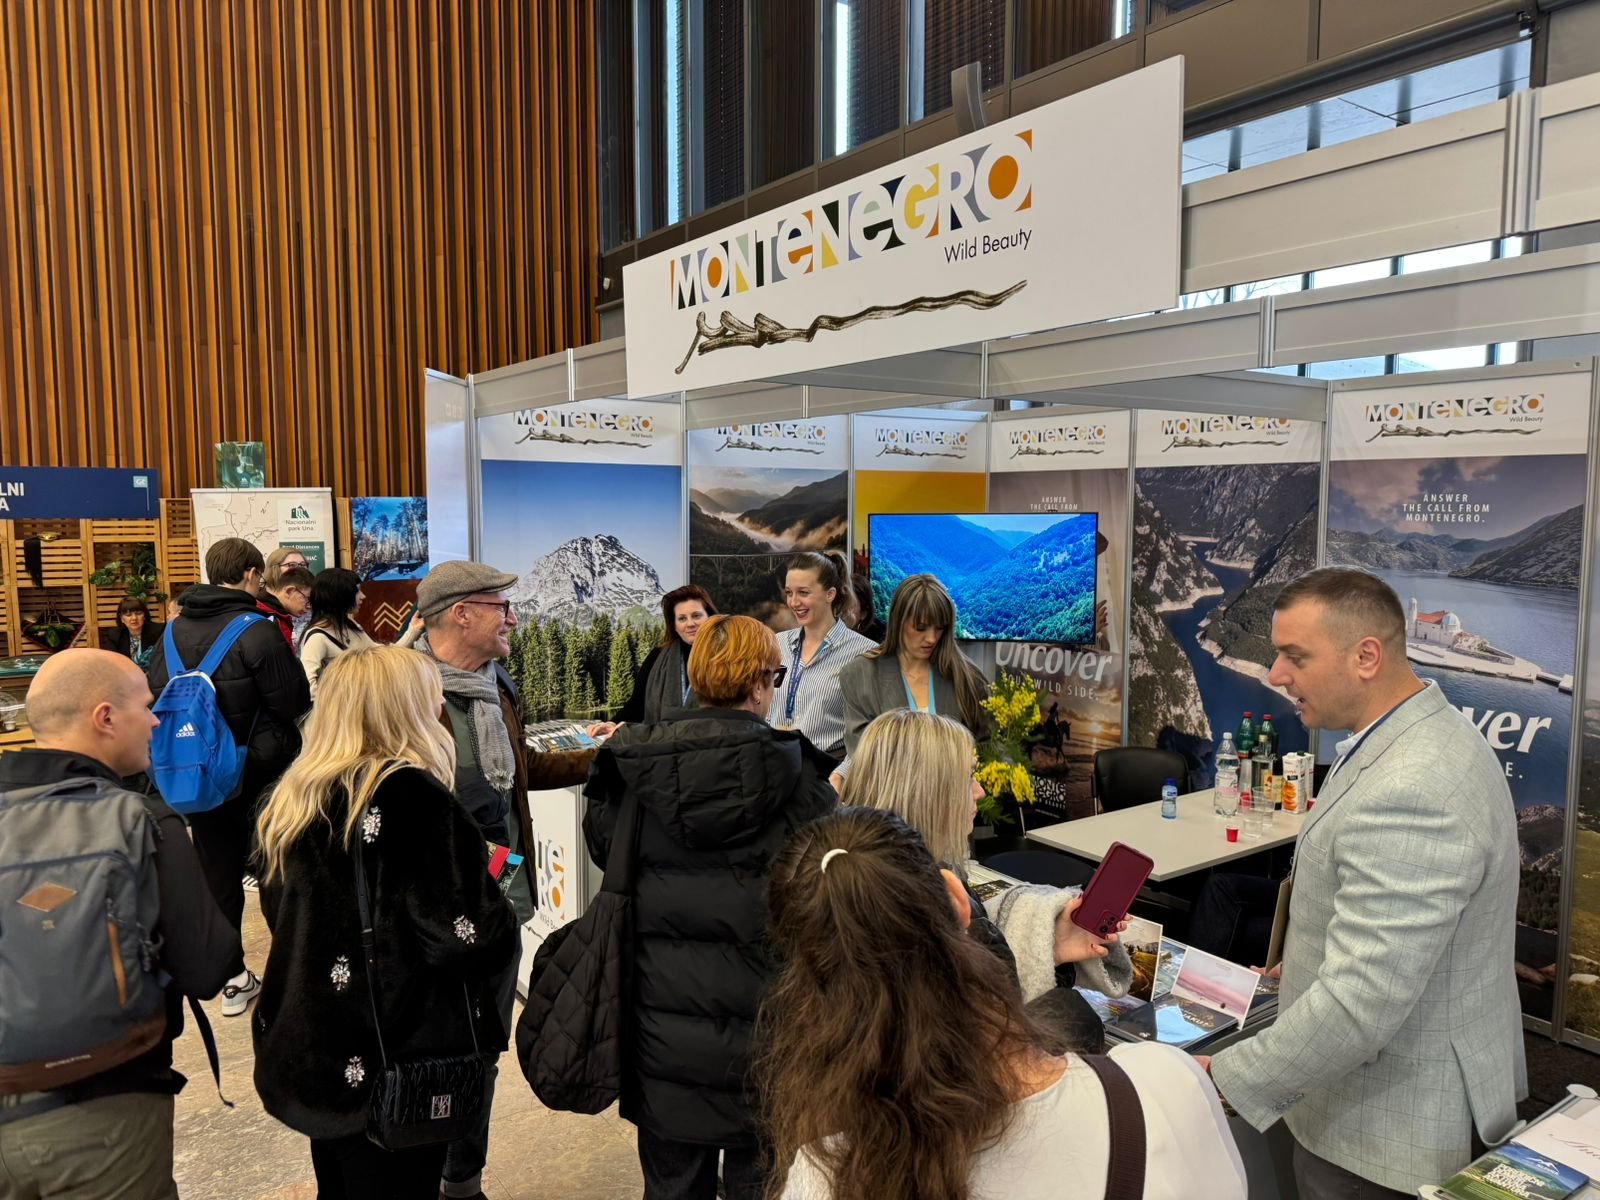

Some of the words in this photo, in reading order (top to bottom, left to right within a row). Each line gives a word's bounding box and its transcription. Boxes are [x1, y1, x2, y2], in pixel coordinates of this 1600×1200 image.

[944, 237, 977, 263] Wild
[983, 229, 1032, 255] Beauty
[1423, 494, 1468, 502] ANSWER
[1402, 503, 1421, 512] THE
[1427, 503, 1453, 512] CALL
[1459, 503, 1490, 512] FROM
[1405, 513, 1485, 523] MONTENEGRO.
[996, 641, 1113, 682] Uncover
[1034, 678, 1061, 692] WILD
[1068, 684, 1099, 701] SIDE.
